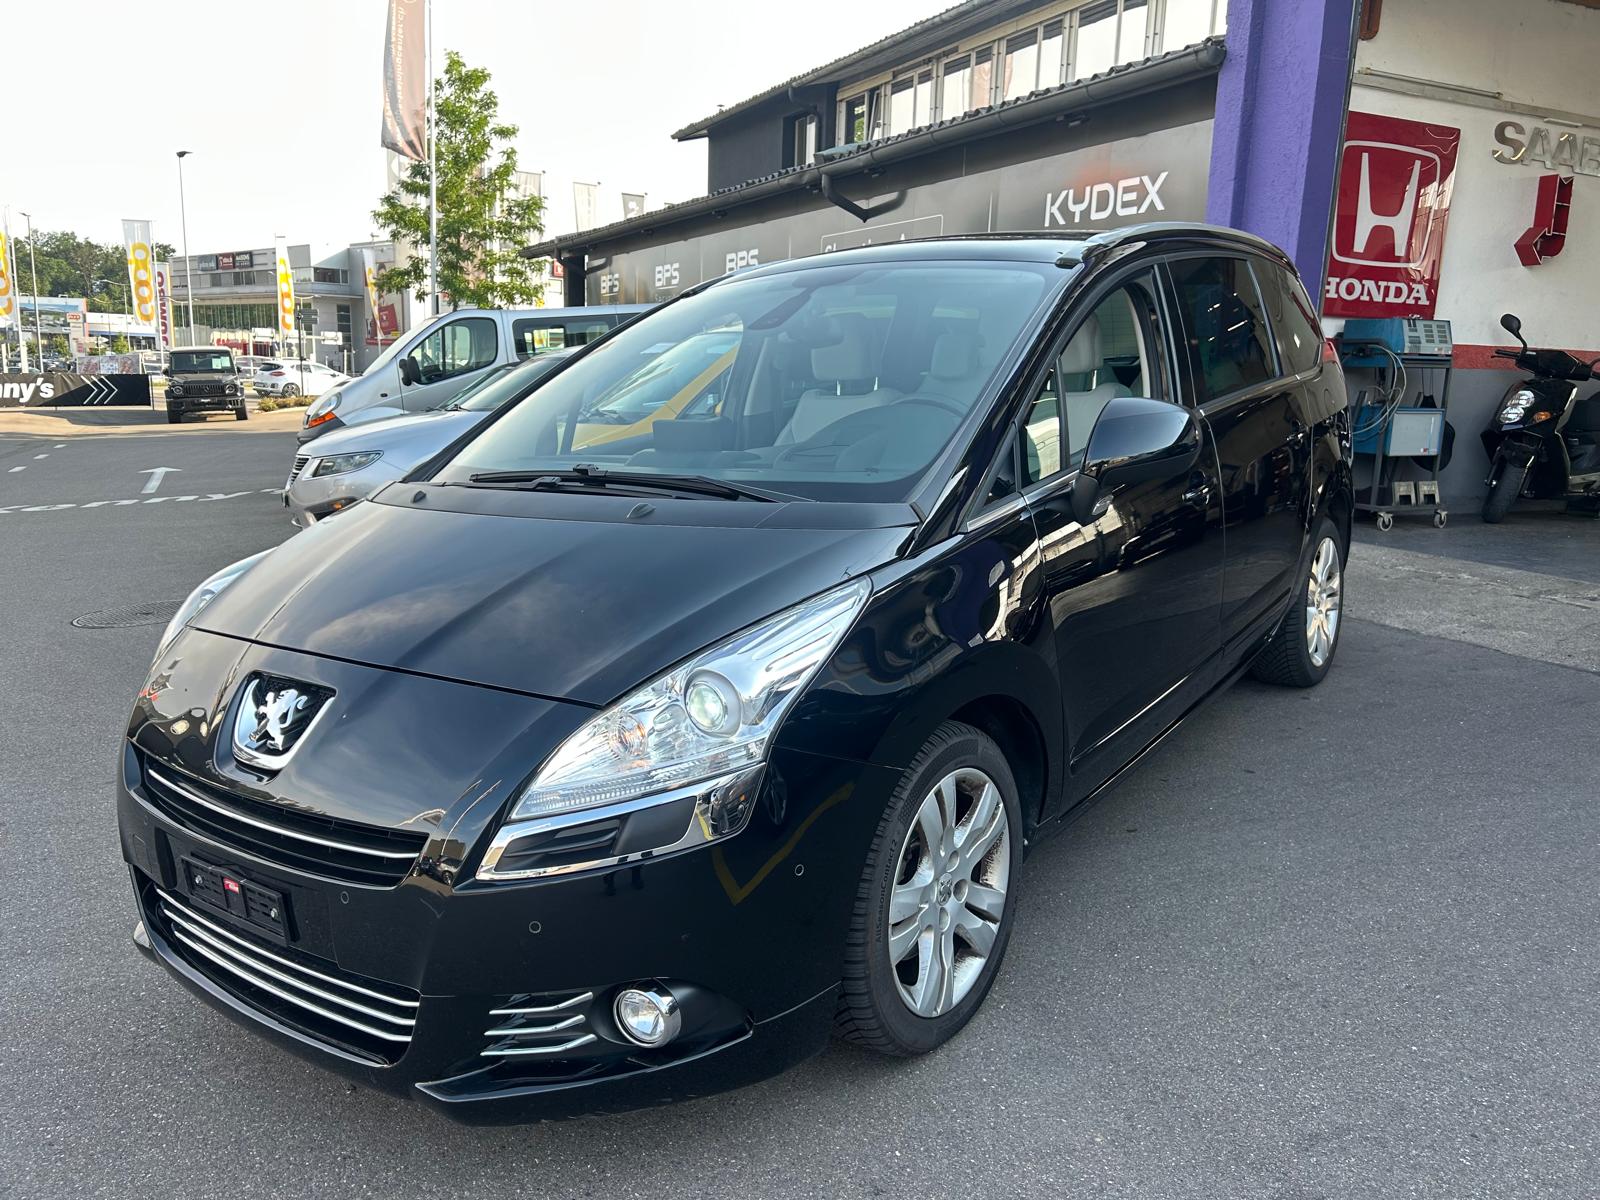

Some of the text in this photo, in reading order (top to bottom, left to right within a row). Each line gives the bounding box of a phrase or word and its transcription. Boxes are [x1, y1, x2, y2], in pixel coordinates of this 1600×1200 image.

[1044, 171, 1169, 228] KYDEX
[726, 248, 759, 274] BPS
[600, 273, 620, 294] BPS
[655, 262, 680, 287] BPS
[1325, 276, 1430, 305] HONDA
[0, 377, 55, 403] ny's
[874, 847, 896, 943] AllSeasonContact
